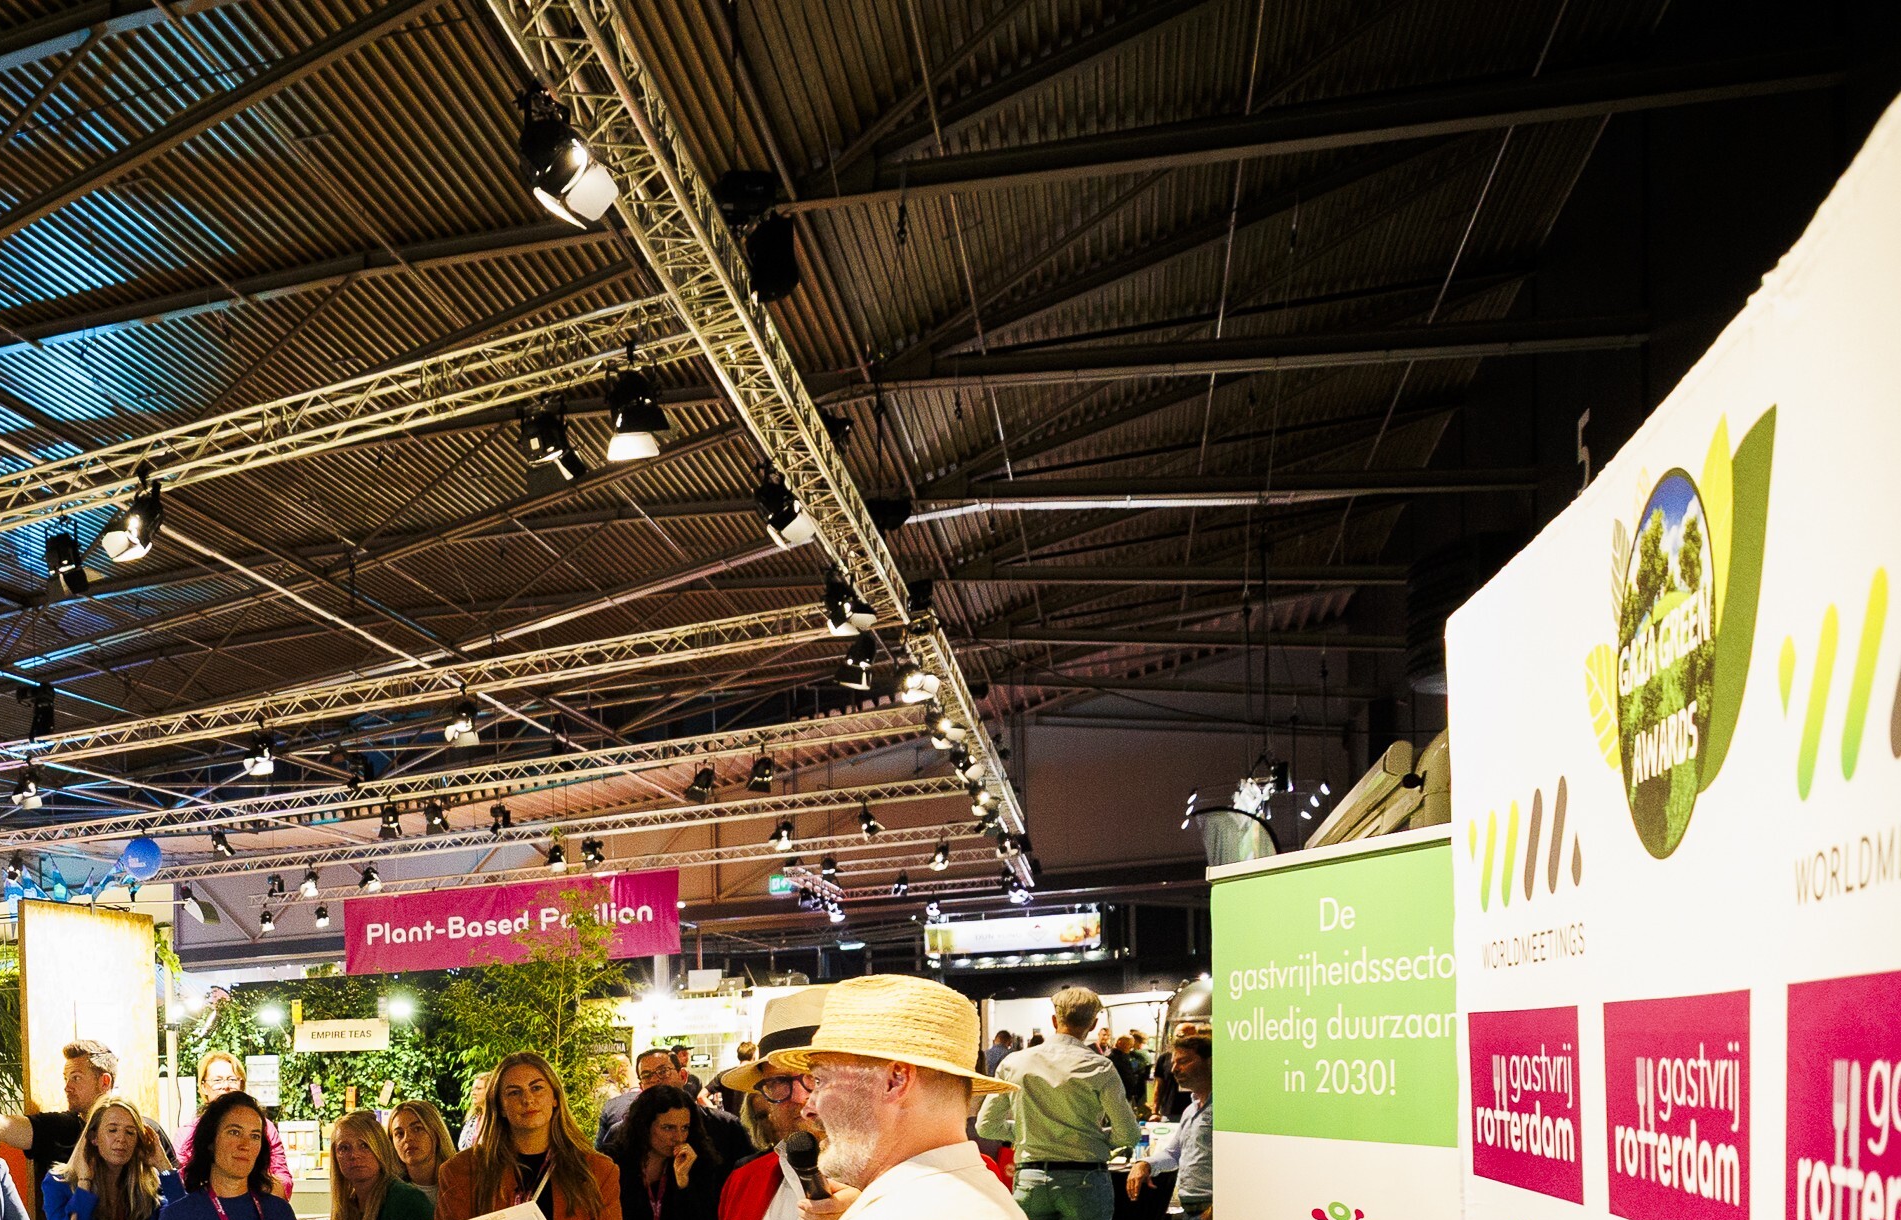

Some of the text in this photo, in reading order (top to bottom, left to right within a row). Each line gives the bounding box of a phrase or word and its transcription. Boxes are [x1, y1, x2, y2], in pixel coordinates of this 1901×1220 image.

[1618, 587, 1712, 697] GAIA GREEN
[1630, 699, 1699, 788] AWARDS
[1794, 824, 1901, 906] WORLDM
[365, 901, 653, 947] Plant-Based Pailion
[1318, 896, 1356, 933] De
[1481, 920, 1586, 970] WORLDMEETINGS
[311, 1028, 373, 1041] EMPIRE TEAS
[1226, 1005, 1318, 1050] volledig
[1283, 1057, 1398, 1098] in 2030!
[1508, 1043, 1574, 1110] gastvrij
[1656, 1042, 1741, 1133] gastvrij
[1475, 1102, 1575, 1164] rotterdam
[1614, 1121, 1741, 1206] rotterdam
